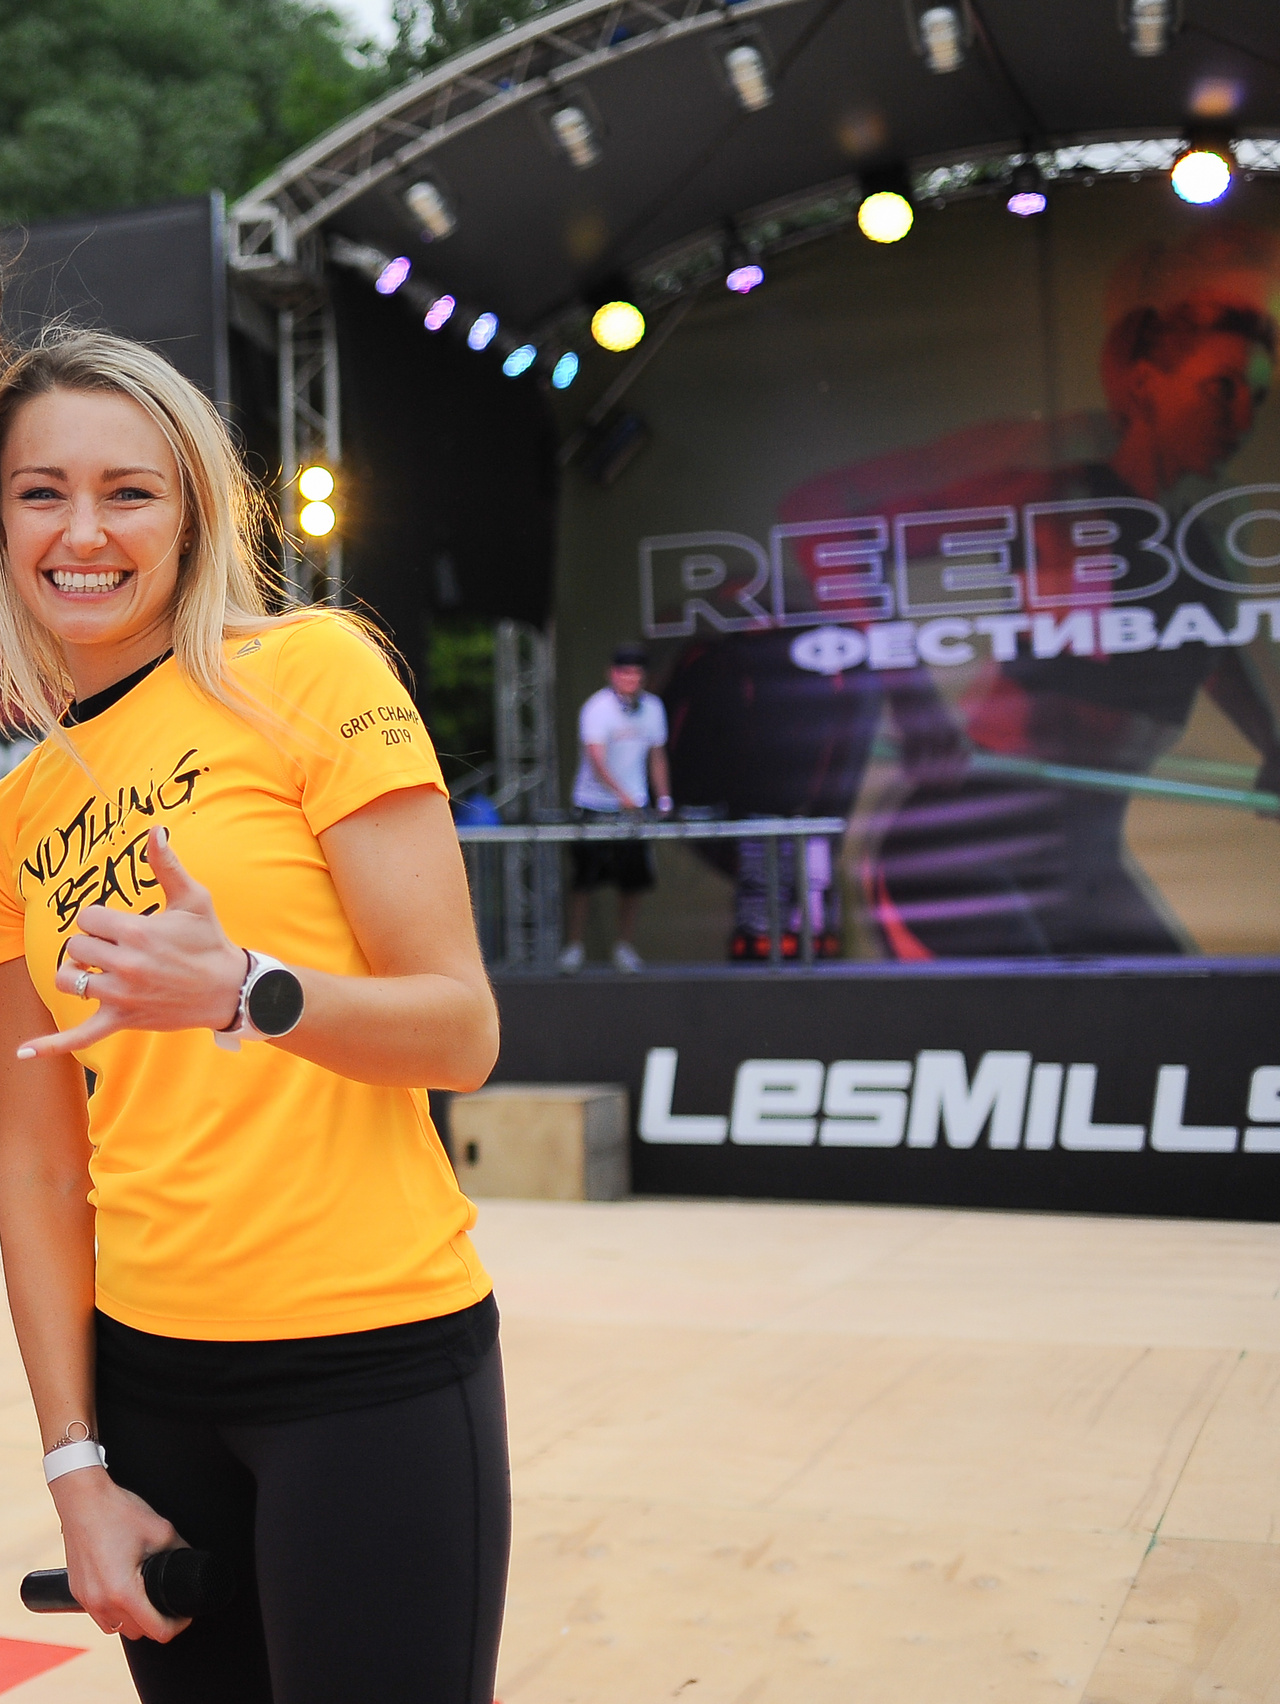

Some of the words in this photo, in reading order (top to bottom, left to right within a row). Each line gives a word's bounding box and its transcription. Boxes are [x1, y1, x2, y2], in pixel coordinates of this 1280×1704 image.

[790, 598, 1280, 675] ФЕСТИВАЛ
[340, 710, 376, 739] GRIT
[381, 728, 412, 746] 2019
